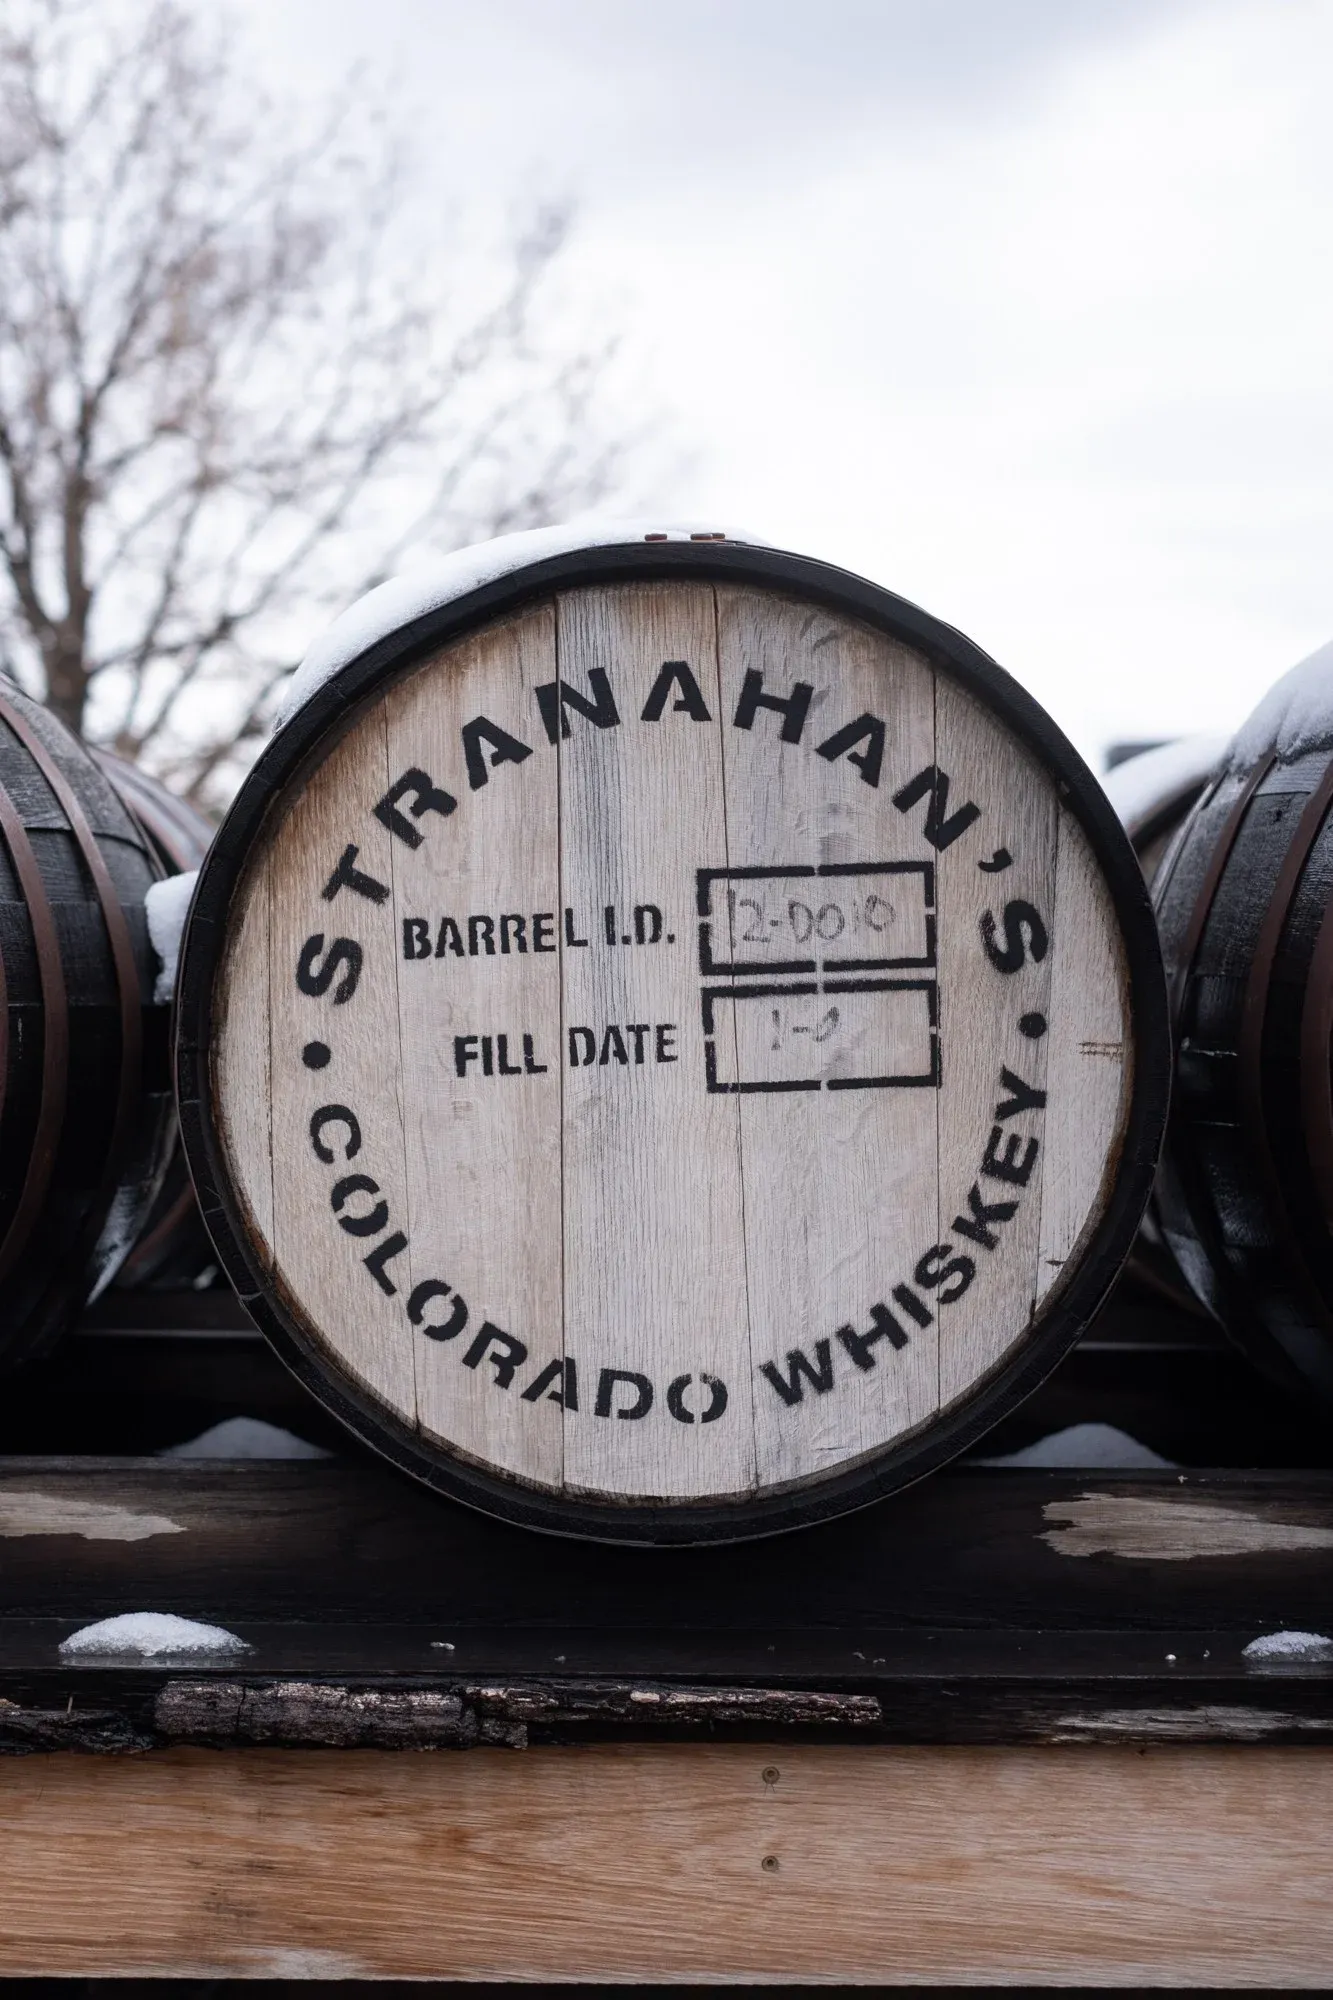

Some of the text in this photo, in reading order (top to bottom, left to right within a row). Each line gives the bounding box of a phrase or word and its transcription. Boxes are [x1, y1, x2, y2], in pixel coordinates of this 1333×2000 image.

[297, 662, 1049, 1004] STRANAHAN'S
[402, 905, 676, 959] BARREL I.D.
[454, 1023, 679, 1077] FILL DATE
[310, 1066, 1047, 1424] COLORADO WHISKEY
